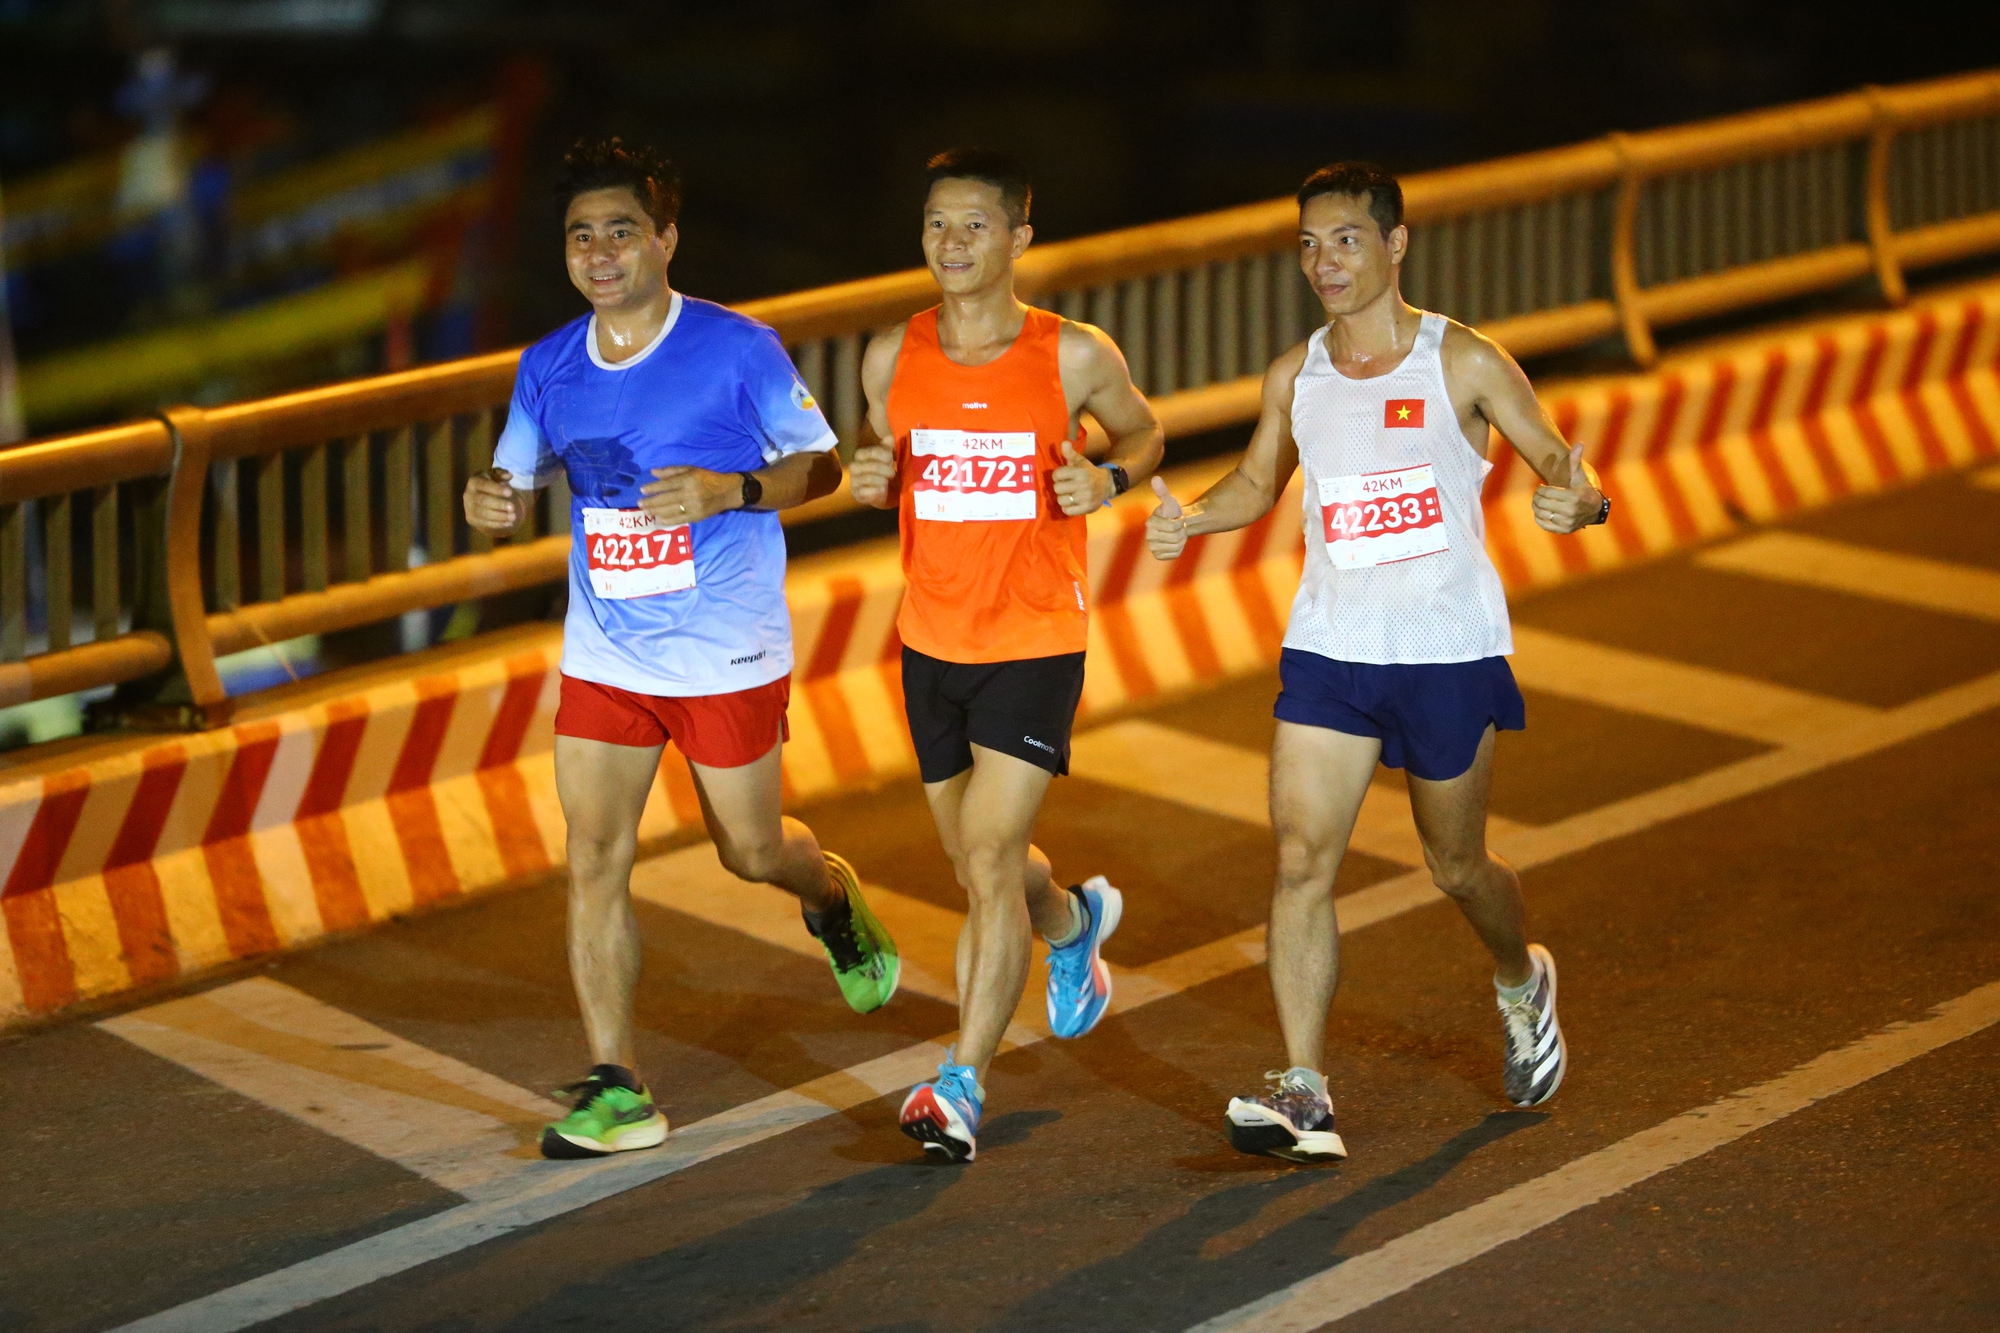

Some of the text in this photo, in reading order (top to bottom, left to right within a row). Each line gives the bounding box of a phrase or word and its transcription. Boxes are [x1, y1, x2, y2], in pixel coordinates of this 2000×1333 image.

[963, 438, 1003, 450] 42KM
[922, 459, 1017, 488] 42172
[1362, 477, 1402, 493] 42KM
[619, 515, 657, 528] 42KM
[1330, 497, 1422, 535] 42233
[592, 533, 671, 566] 42217
[1023, 735, 1055, 754] Coolmate
